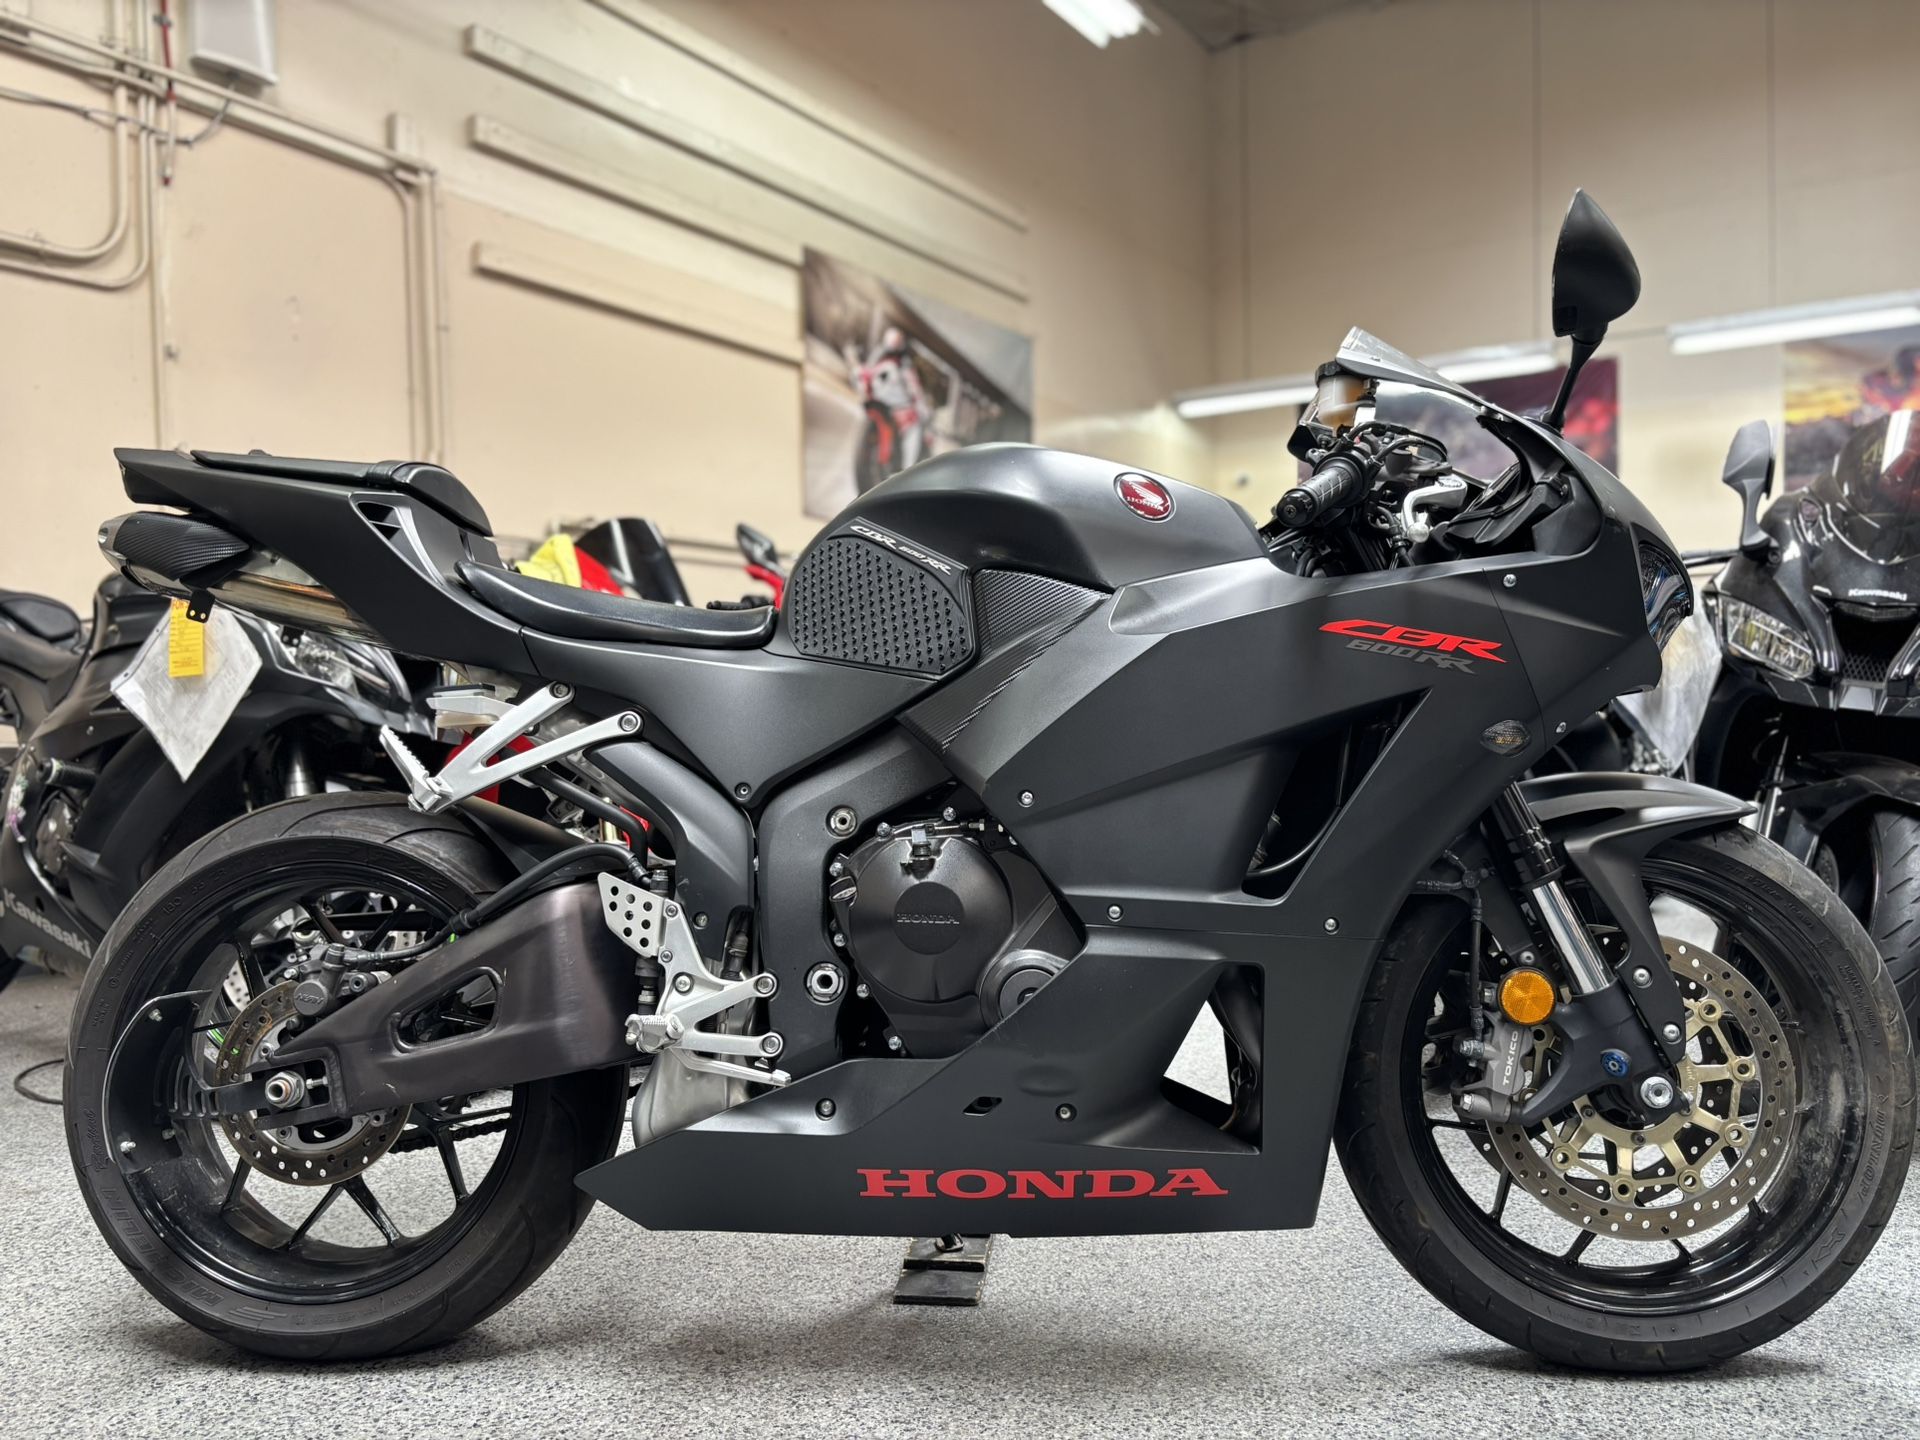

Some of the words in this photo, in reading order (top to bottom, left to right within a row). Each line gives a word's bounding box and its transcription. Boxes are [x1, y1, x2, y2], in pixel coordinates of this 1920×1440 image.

[850, 525, 897, 550] CBR
[1847, 588, 1908, 601] Kawasaki
[1318, 619, 1508, 664] CBR
[3, 887, 92, 960] Kawasaki
[897, 913, 960, 925] HONDA
[1502, 1031, 1519, 1086] TOKICO
[857, 1168, 1229, 1199] HONDA
[101, 1187, 225, 1307] MICHELIN
